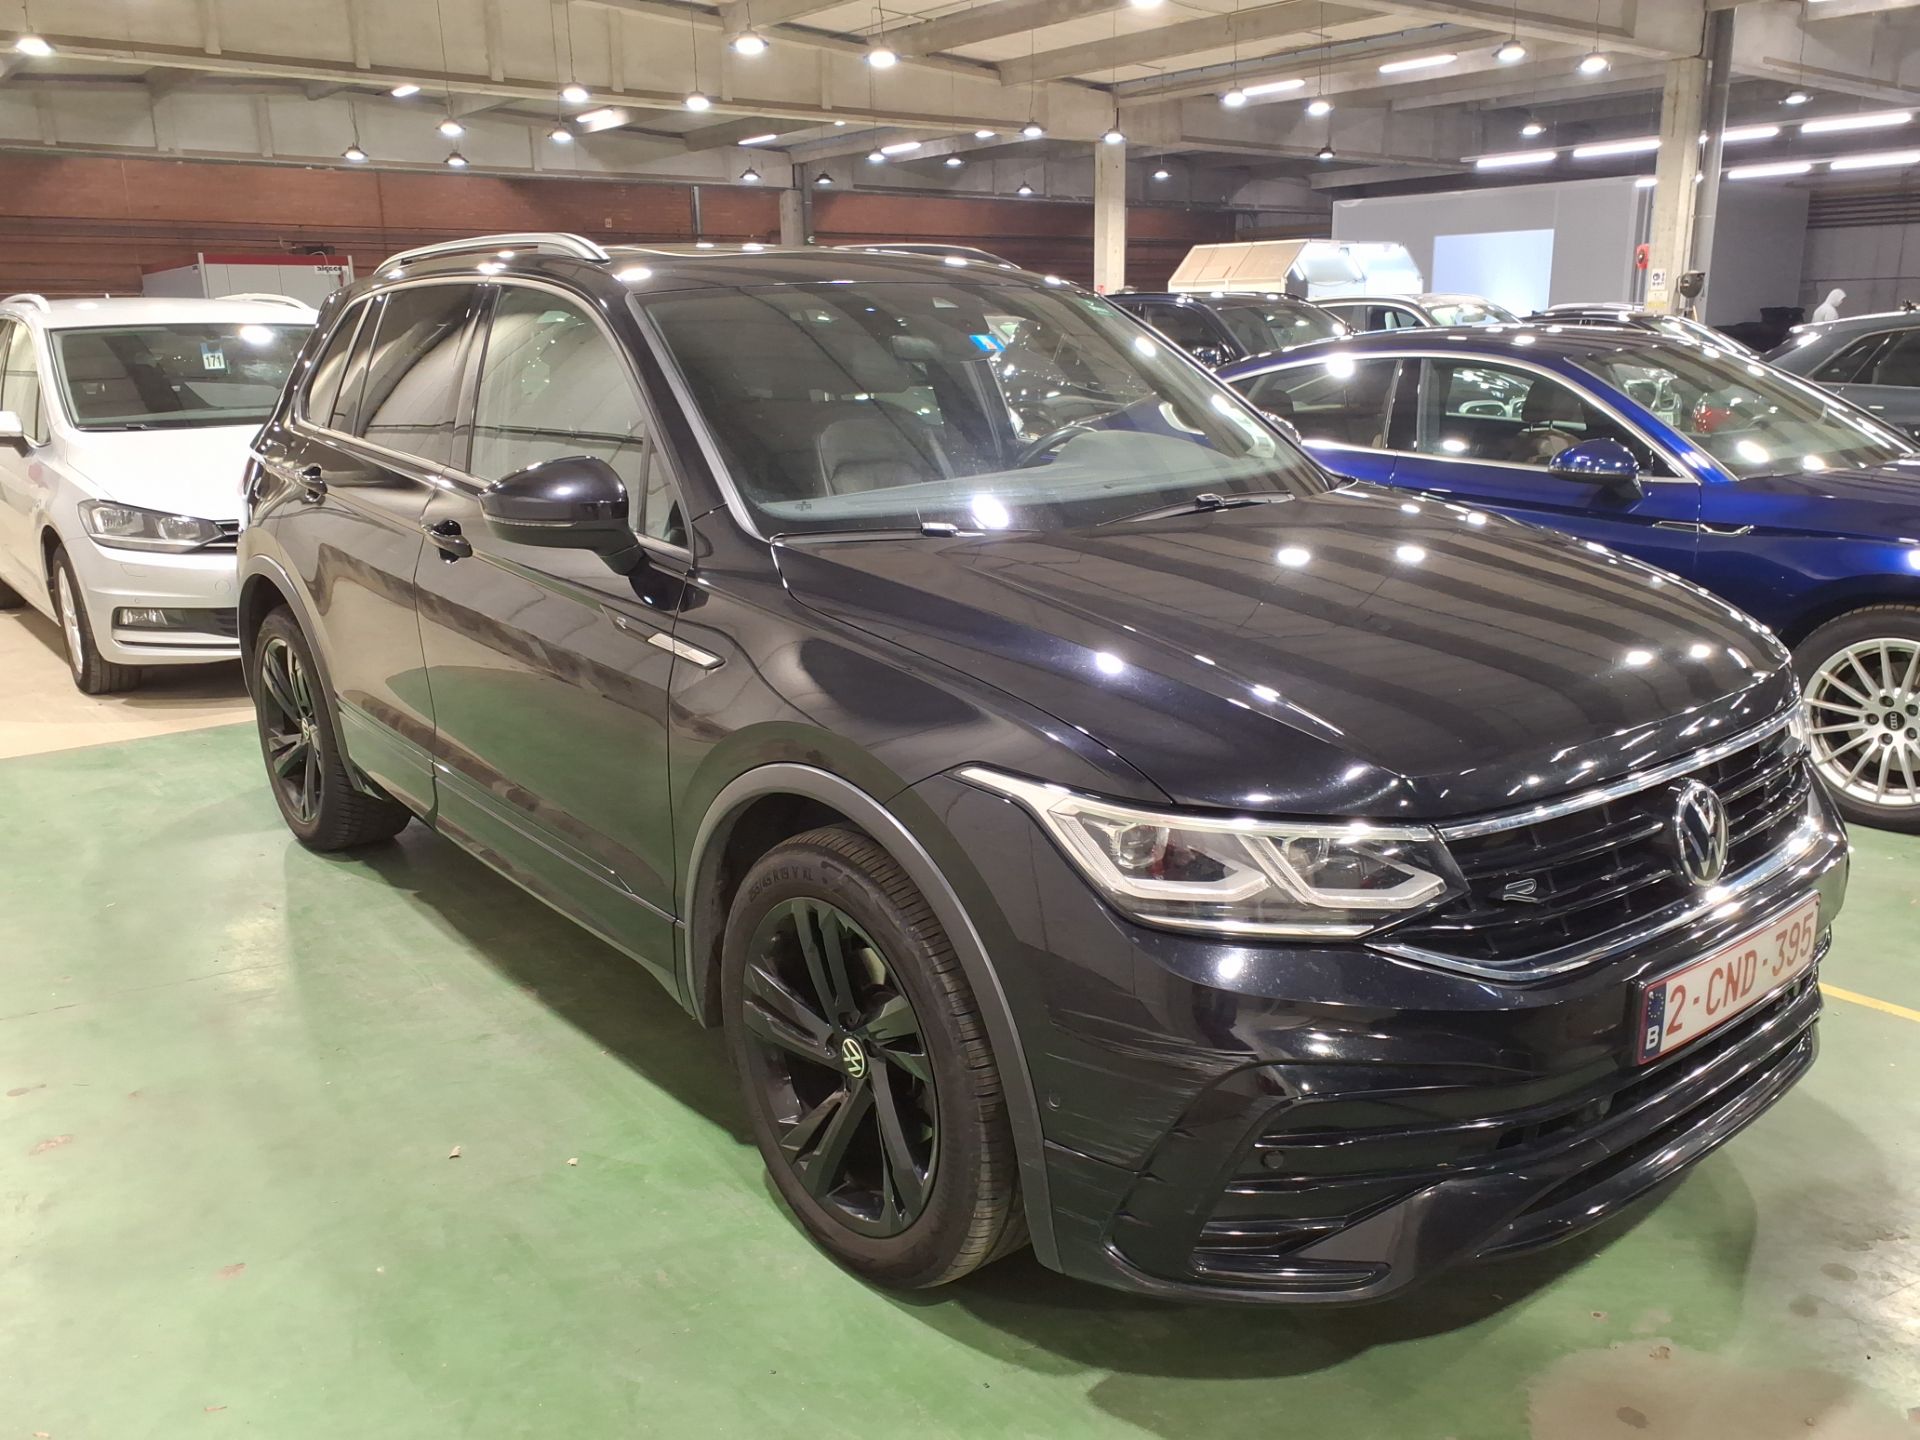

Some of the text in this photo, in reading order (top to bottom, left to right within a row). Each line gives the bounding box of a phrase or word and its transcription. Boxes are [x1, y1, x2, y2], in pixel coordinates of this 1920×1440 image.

[205, 354, 222, 367] 171
[1665, 911, 1815, 1037] 2-CND-395
[1645, 1024, 1660, 1050] B
